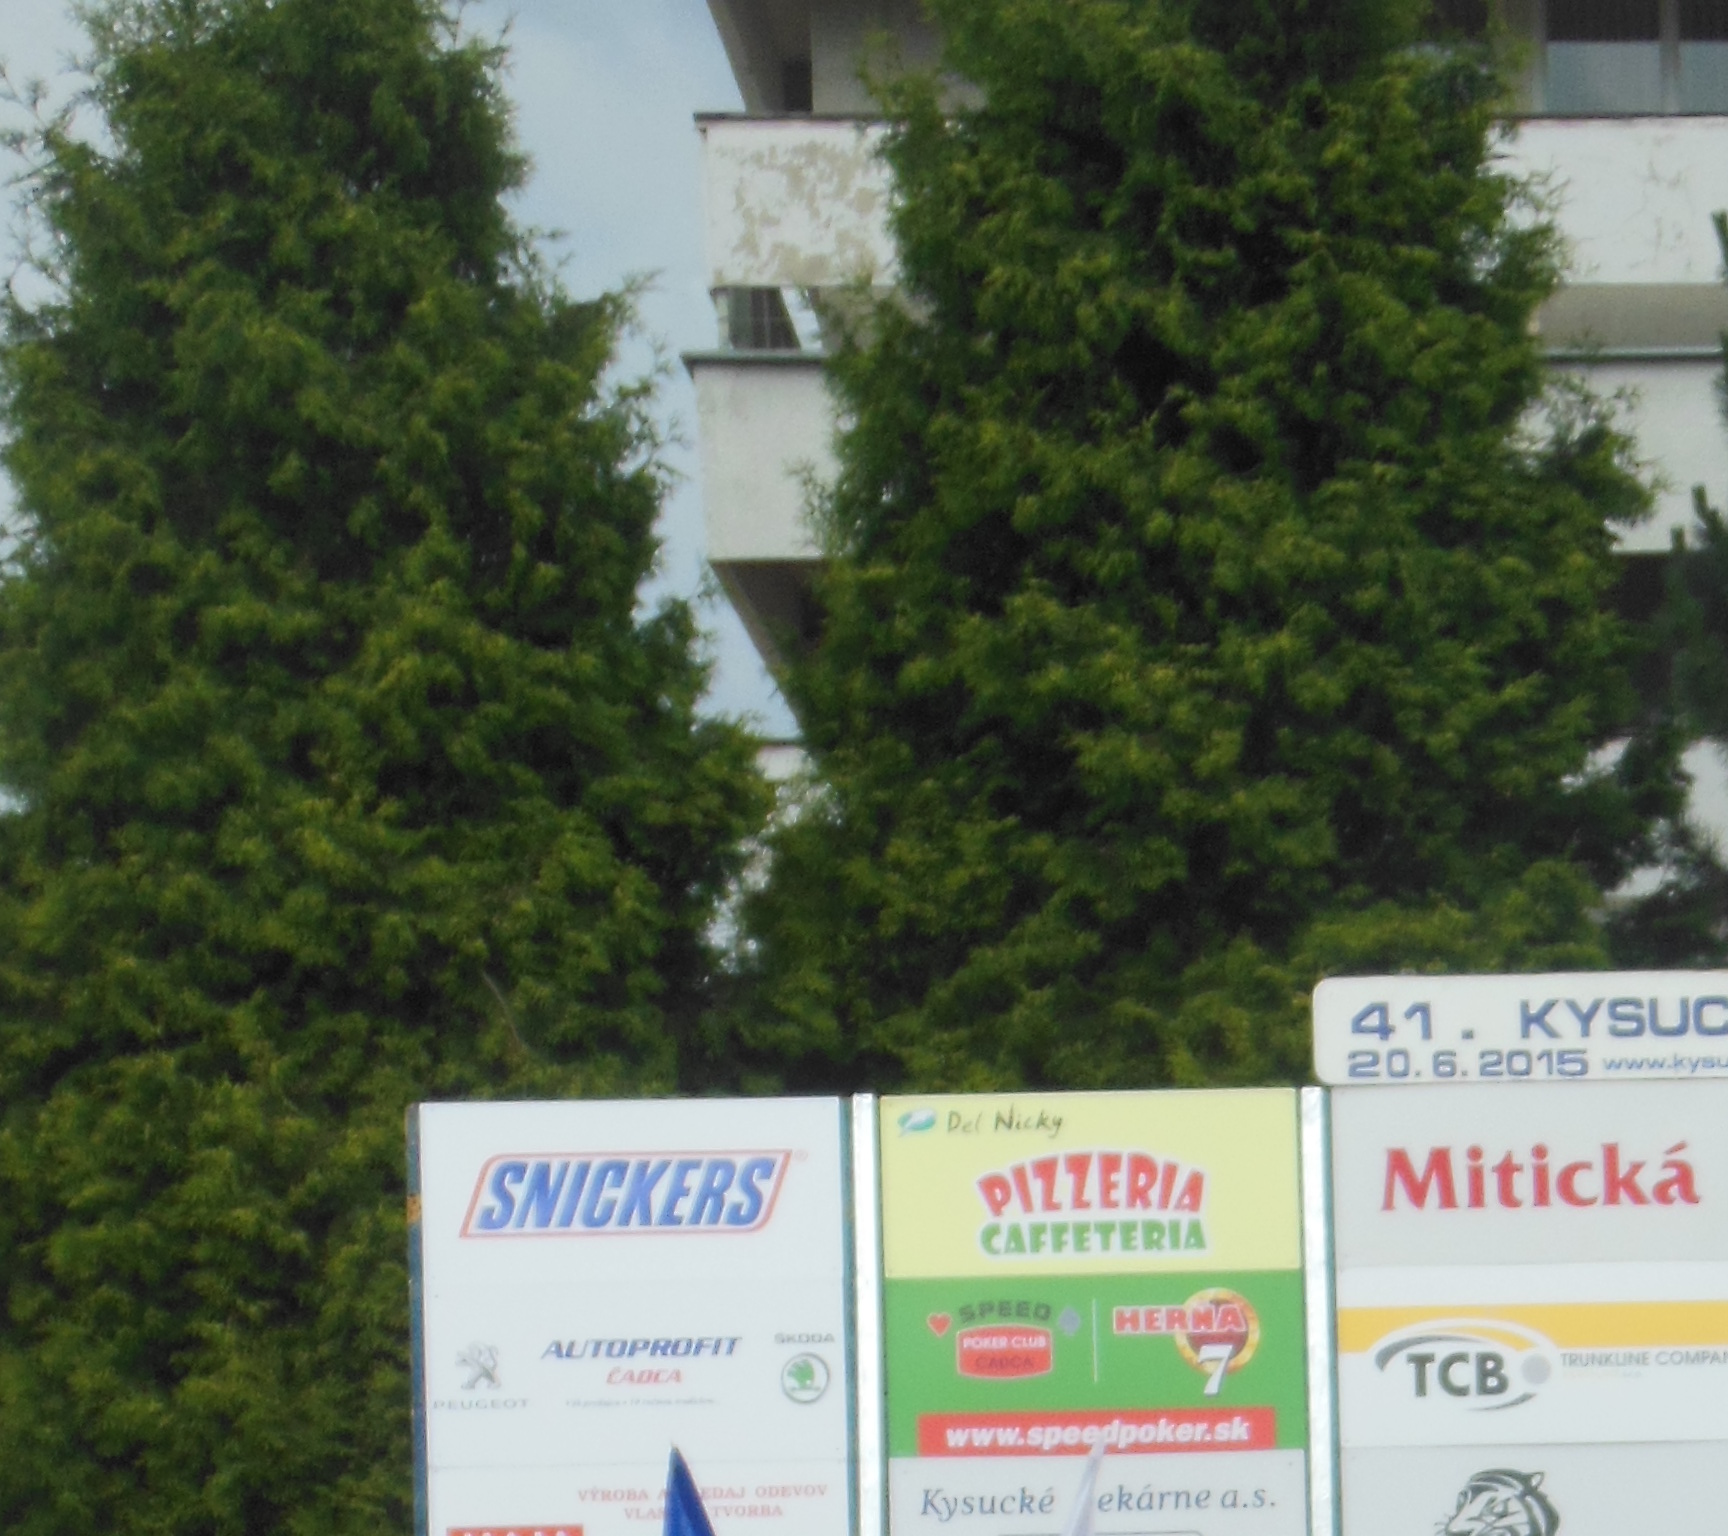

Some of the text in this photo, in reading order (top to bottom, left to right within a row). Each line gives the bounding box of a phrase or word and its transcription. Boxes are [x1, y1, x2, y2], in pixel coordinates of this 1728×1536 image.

[1347, 1048, 1589, 1078] 20.6.2015
[994, 1103, 1063, 1139] Nicky
[978, 1152, 1205, 1217] PIZZERIA
[1380, 1140, 1701, 1212] Mitická
[476, 1156, 776, 1230] SNICKERS
[980, 1218, 1207, 1256] CAFFETERIA
[959, 1299, 1051, 1323] SPEED
[1114, 1306, 1247, 1334] HERNA
[541, 1336, 742, 1360] AUTOPROFIT
[963, 1335, 1046, 1350] POKER CLUB
[1197, 1344, 1233, 1397] 7
[1406, 1352, 1510, 1398] TCB
[1560, 1352, 1650, 1368] TRUNKLINE
[605, 1366, 684, 1385] ČADCA
[433, 1398, 530, 1411] PEUGEOT
[946, 1417, 1250, 1450] www.speedpoker.sk
[578, 1485, 648, 1501] VÝROBA
[755, 1484, 828, 1499] ODEVOV
[920, 1484, 1277, 1523] Kysucké ekárne a.s.
[713, 1503, 784, 1518] TVORBA
